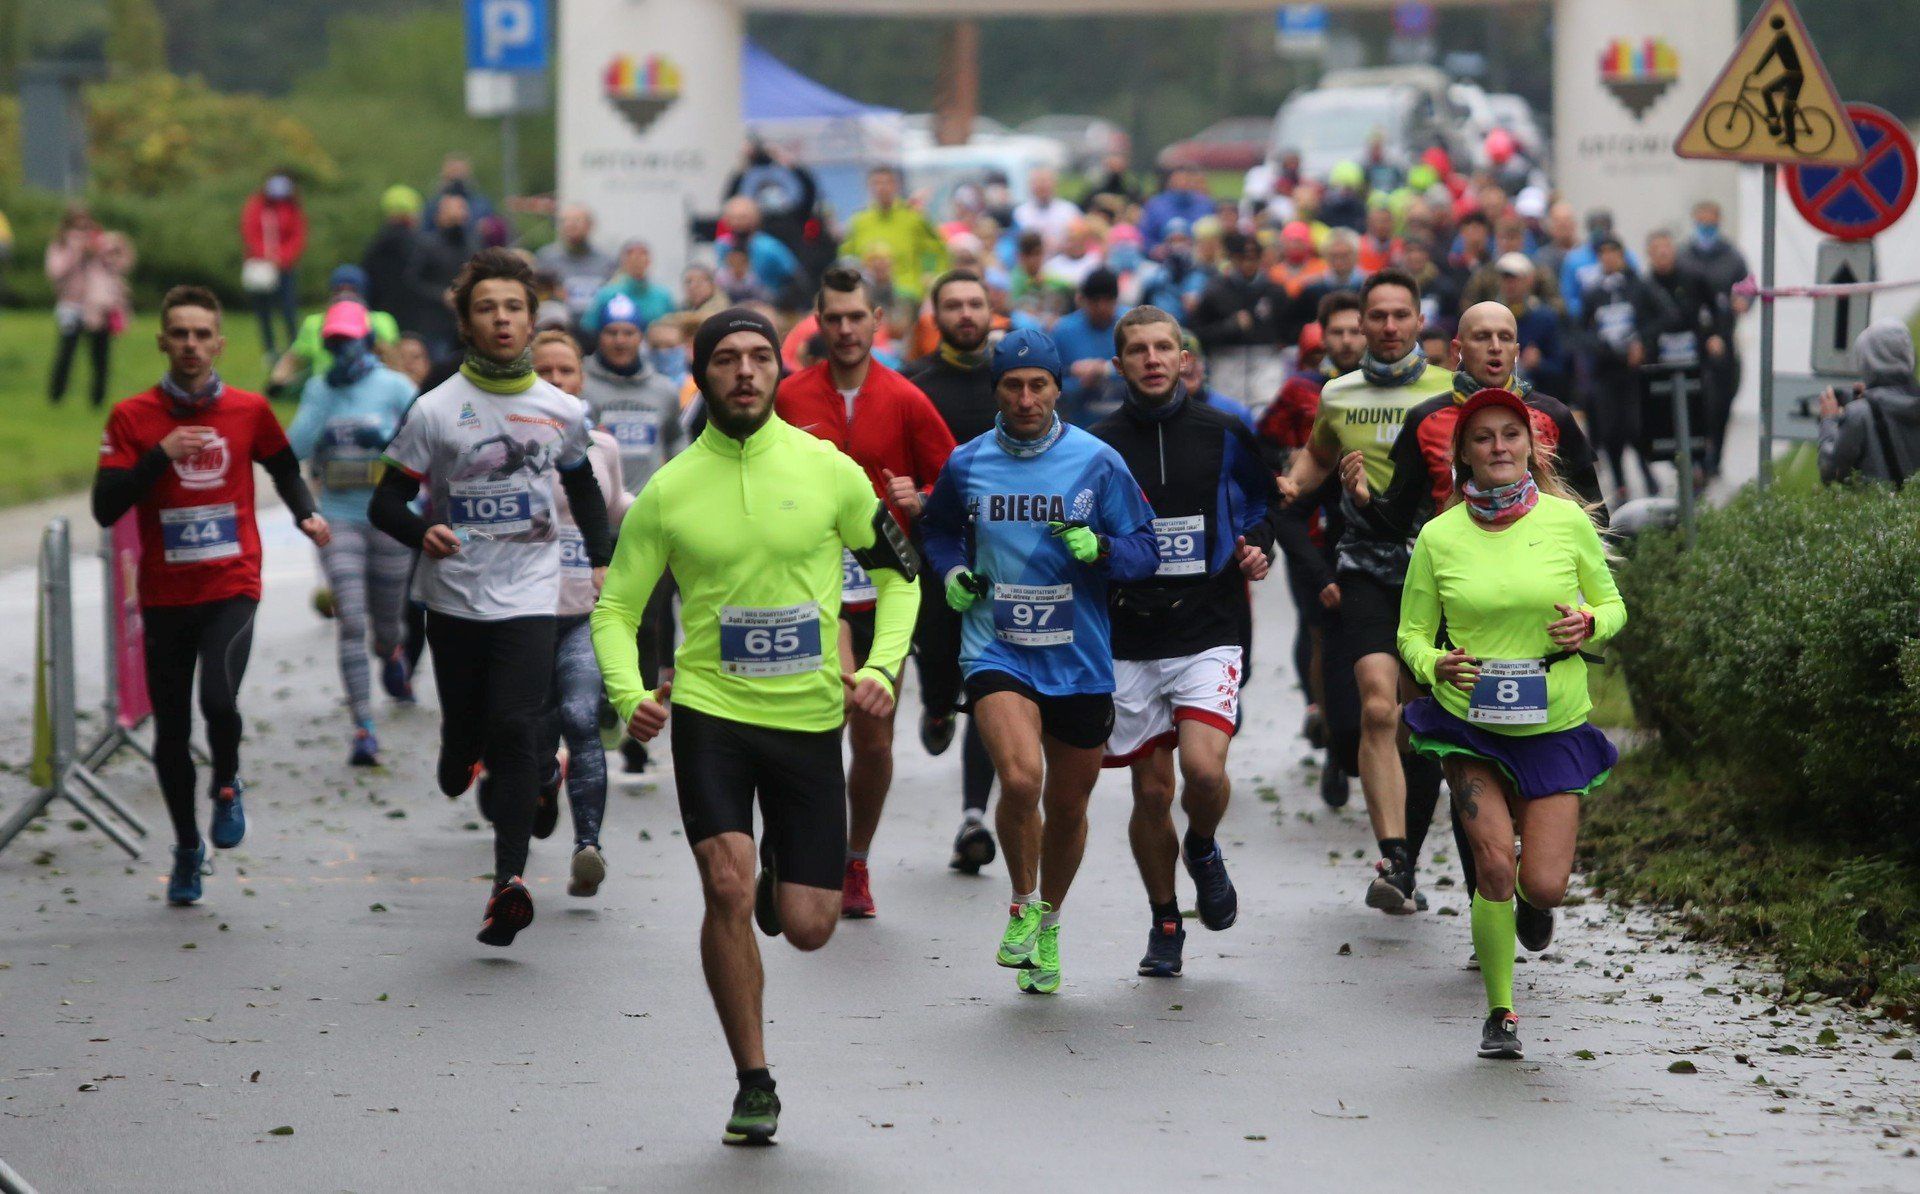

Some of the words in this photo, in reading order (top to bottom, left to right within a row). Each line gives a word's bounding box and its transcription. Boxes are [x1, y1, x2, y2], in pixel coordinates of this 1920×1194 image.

[482, 0, 535, 62] P
[1345, 407, 1406, 425] MOUNT
[461, 496, 520, 519] 105
[989, 494, 1066, 522] BIEGA
[179, 521, 223, 543] 44
[1156, 534, 1194, 556] 29
[1012, 603, 1055, 626] 97
[744, 625, 800, 655] 65
[1496, 679, 1520, 704] 8
